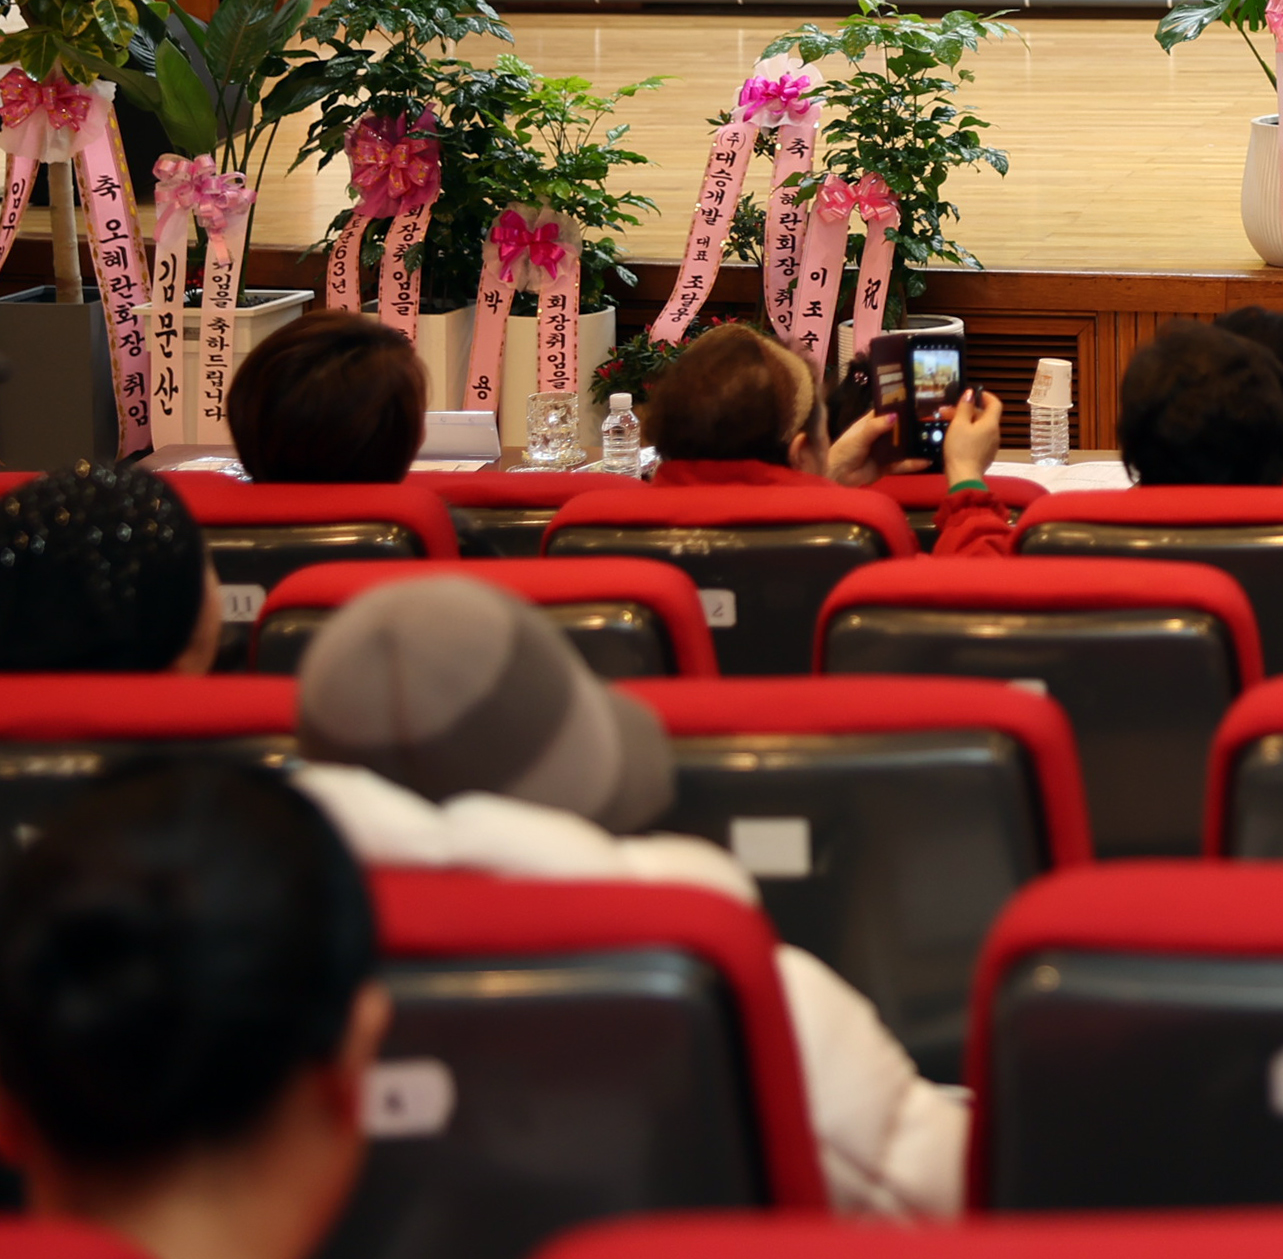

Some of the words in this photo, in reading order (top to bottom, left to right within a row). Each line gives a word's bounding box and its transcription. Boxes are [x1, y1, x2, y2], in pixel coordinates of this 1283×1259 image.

[701, 131, 746, 225] (주)대승개발
[786, 138, 809, 159] 축
[93, 176, 121, 201] 축
[693, 236, 710, 262] 대표
[774, 183, 803, 277] 혜란회장
[98, 219, 146, 357] 오혜란회장
[862, 278, 881, 310] 祝
[204, 317, 230, 422] 축하드립니다
[545, 294, 571, 390] 회장취임을
[123, 372, 150, 426] 취임
